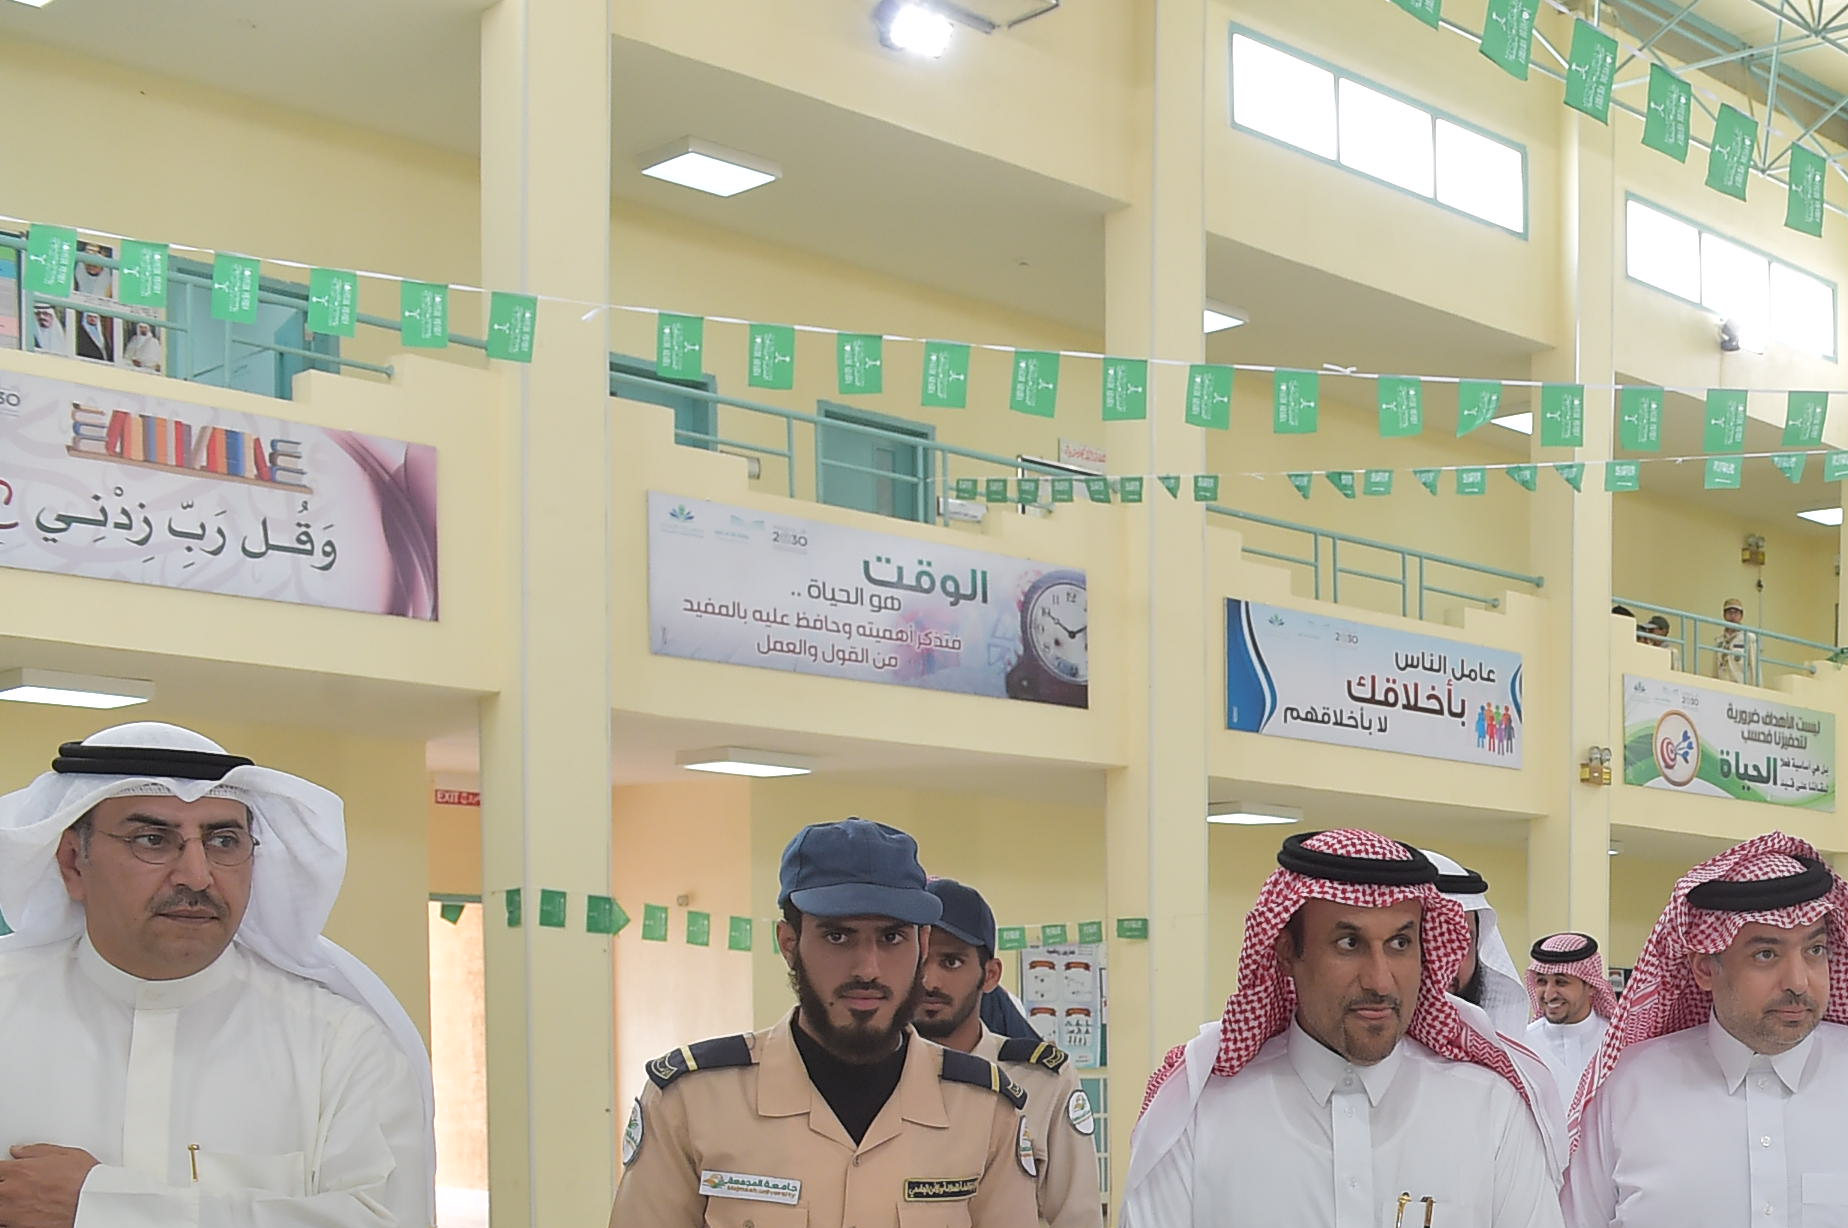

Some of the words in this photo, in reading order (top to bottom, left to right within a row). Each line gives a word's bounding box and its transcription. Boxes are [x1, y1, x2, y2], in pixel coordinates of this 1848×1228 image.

[807, 578, 864, 607] الحياة
[862, 555, 989, 608] الوقت
[682, 597, 747, 625] بالمفيد
[869, 593, 902, 613] هو
[752, 606, 790, 628] عليه
[796, 611, 852, 640] وحافظ
[856, 621, 913, 644] أهميته
[917, 630, 962, 651] فتذكر
[757, 634, 818, 663] والعمل
[822, 643, 869, 667] القول
[872, 651, 898, 670] من
[1395, 651, 1447, 675] الناس
[1451, 659, 1496, 683] عامل
[1346, 675, 1466, 727] بأخلاقك
[1283, 706, 1373, 736] بأخلاقهم
[1377, 715, 1388, 733] لا
[1726, 702, 1760, 725] ضرورية
[1719, 748, 1778, 791] الحياة
[763, 1179, 798, 1192] جامعة
